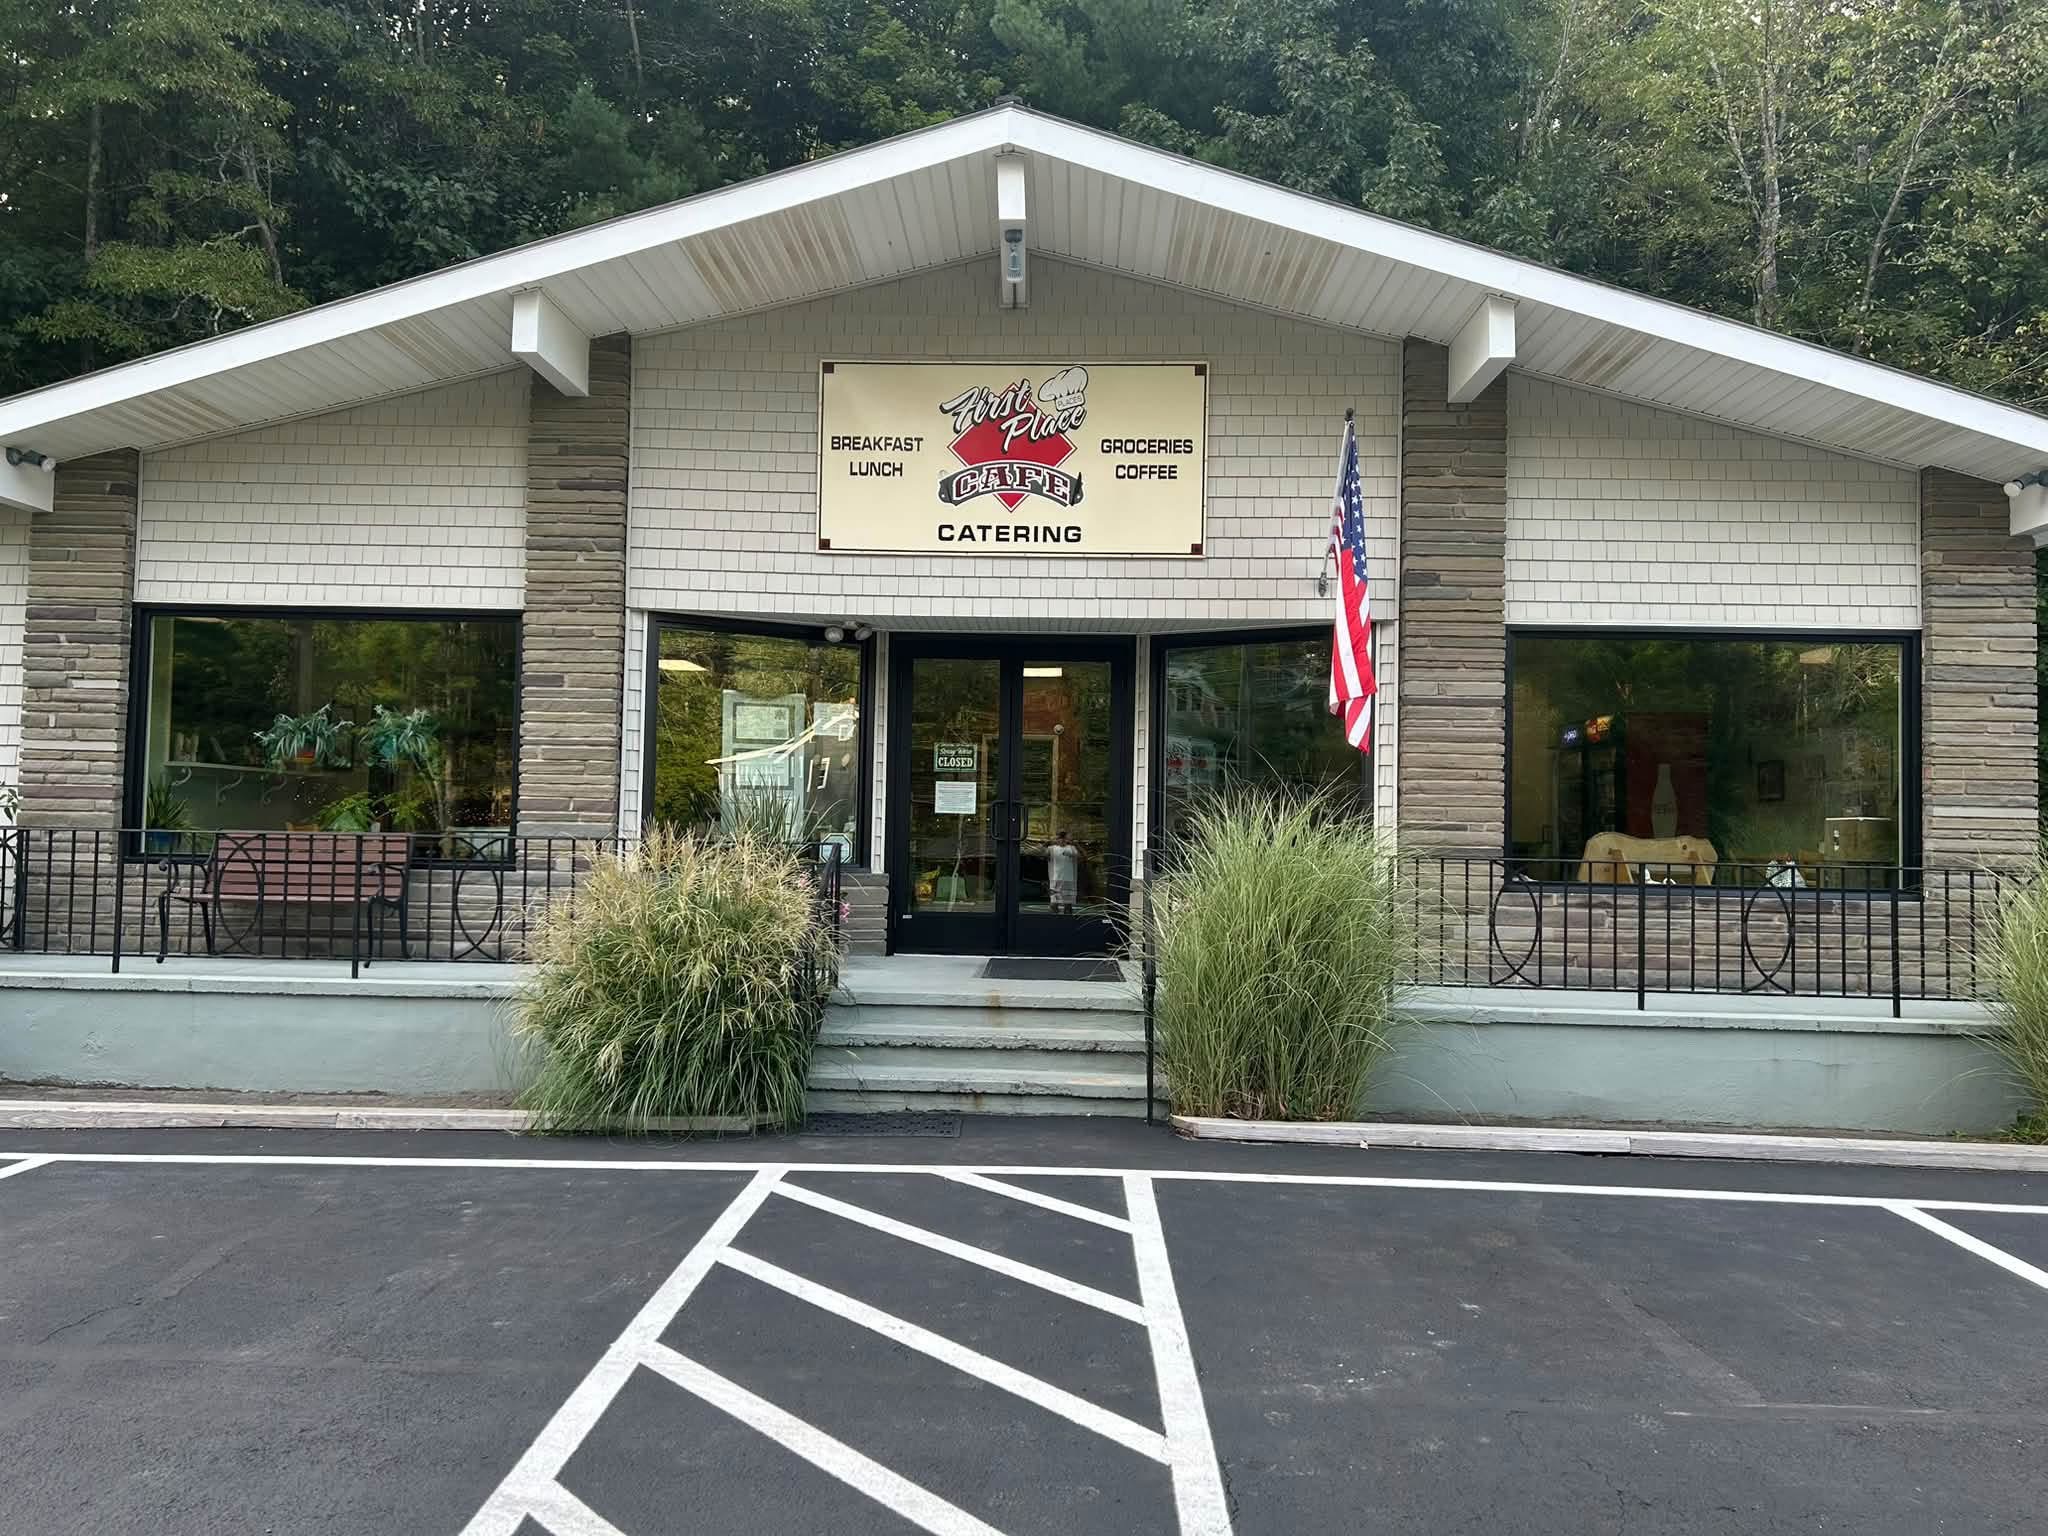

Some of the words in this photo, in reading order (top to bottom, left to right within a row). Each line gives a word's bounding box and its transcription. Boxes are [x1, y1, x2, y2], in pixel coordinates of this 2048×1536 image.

[940, 378, 1031, 433] First
[999, 406, 1087, 454] Place
[831, 435, 923, 452] BREAKFAST
[1101, 438, 1193, 454] GROCERIES
[849, 461, 903, 477] LUNCH
[1115, 464, 1178, 480] COFFEE
[953, 464, 1070, 502] CAFE
[938, 524, 1082, 543] CATERING
[938, 757, 973, 767] CLOSED
